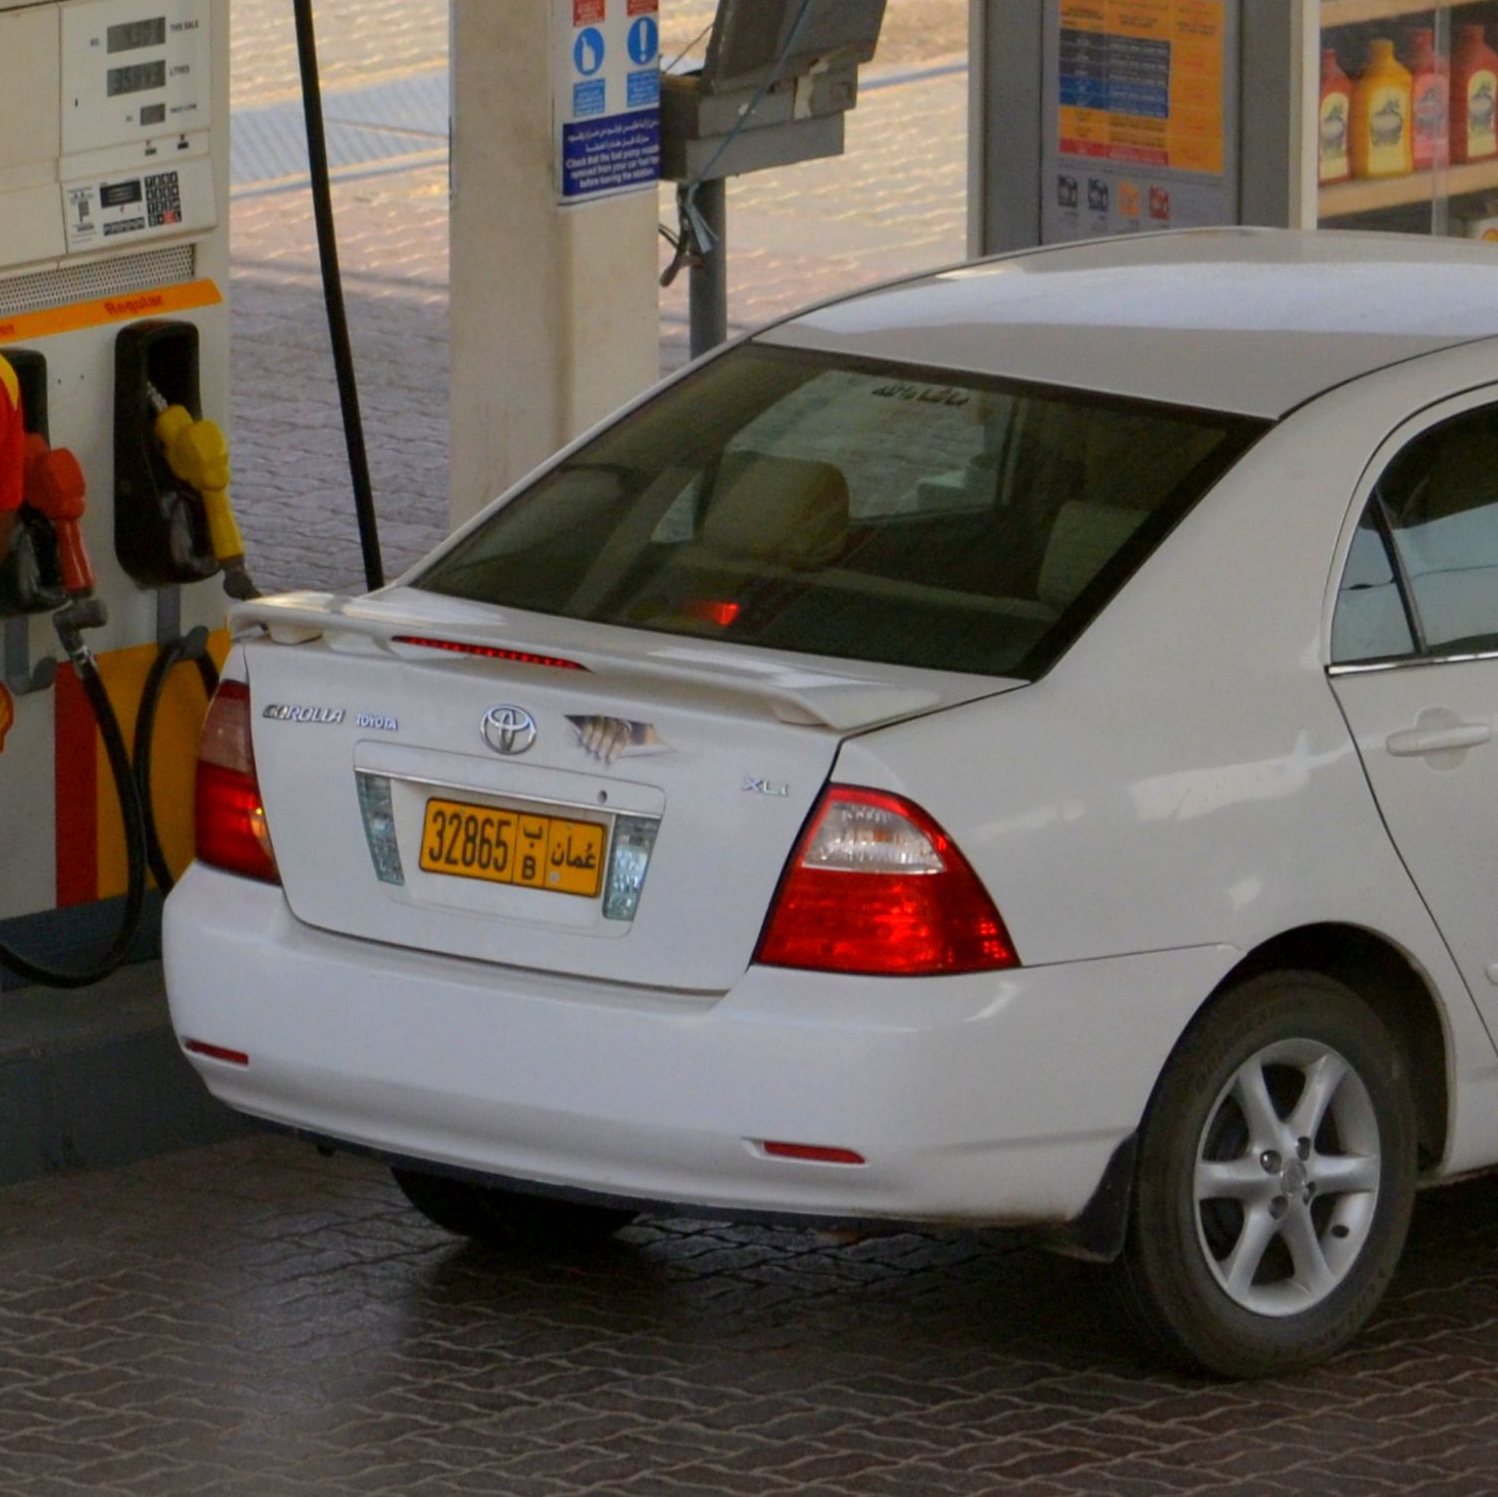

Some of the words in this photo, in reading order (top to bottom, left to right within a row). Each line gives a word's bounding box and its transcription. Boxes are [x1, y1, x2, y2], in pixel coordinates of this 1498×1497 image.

[103, 294, 164, 316] Regular
[262, 704, 346, 724] COROLLA
[356, 713, 399, 731] TOYOTA
[428, 810, 512, 873] 32865
[522, 823, 544, 849] ب
[521, 855, 537, 881] B
